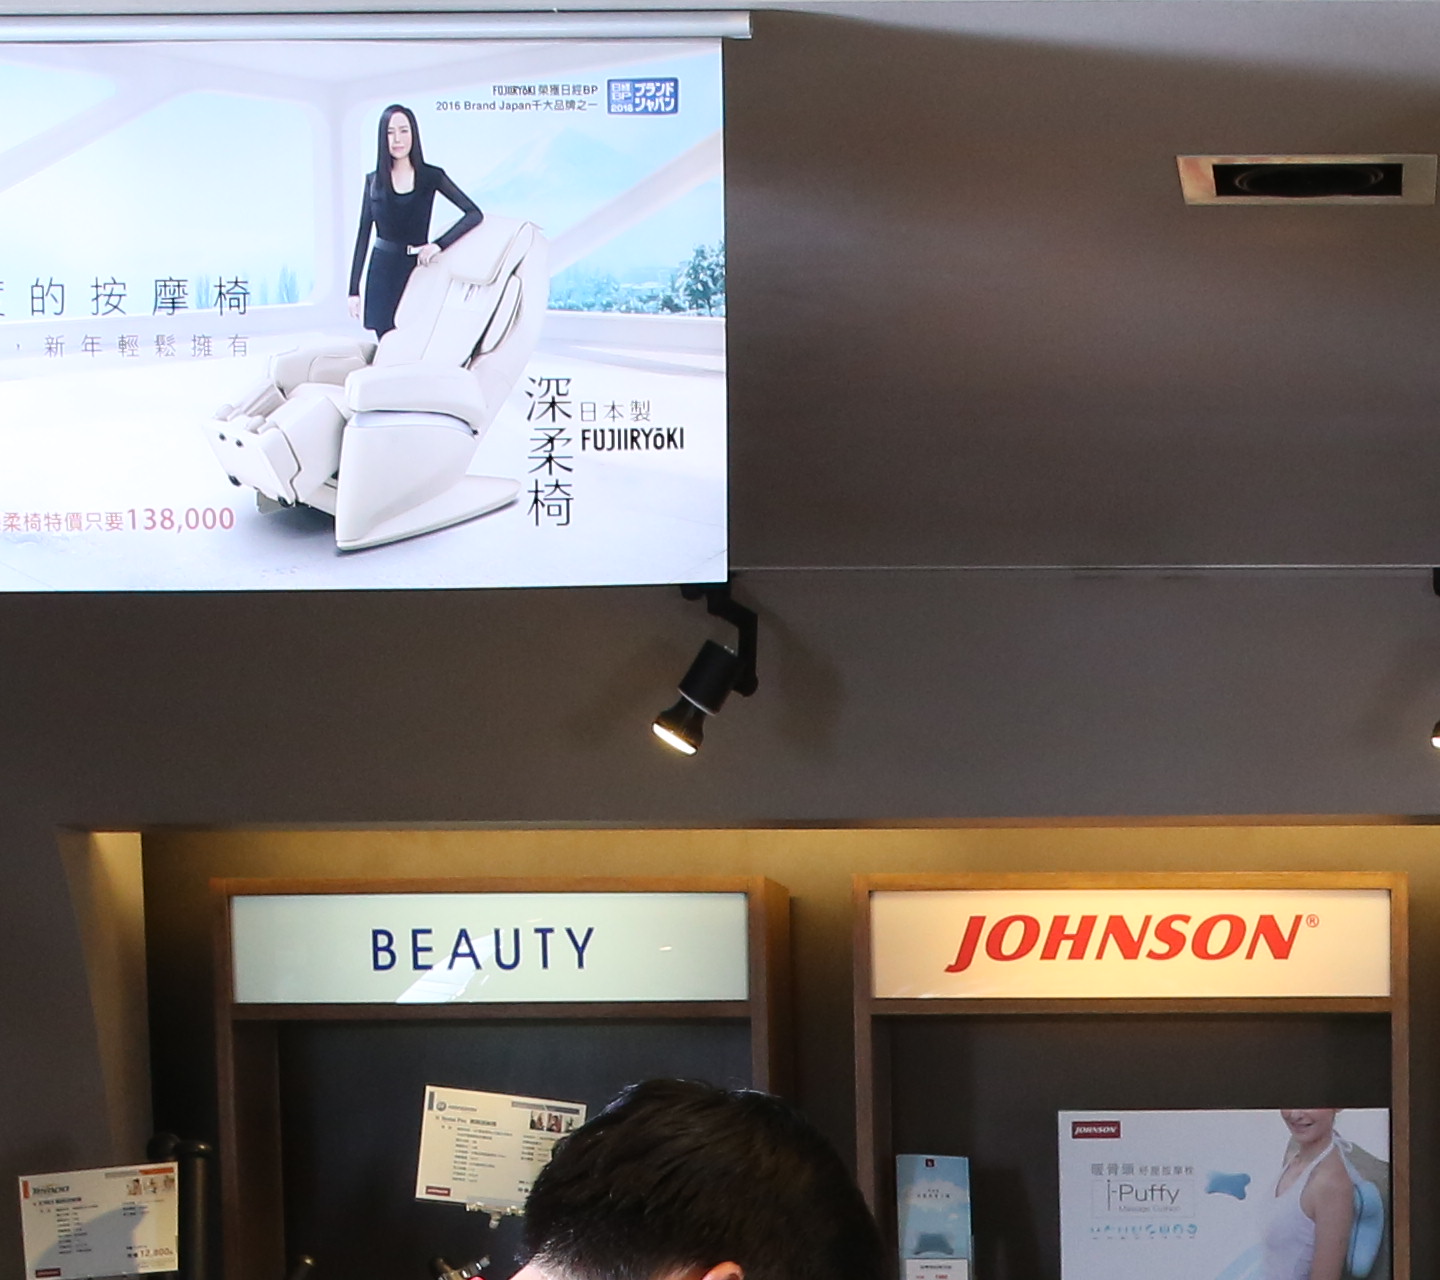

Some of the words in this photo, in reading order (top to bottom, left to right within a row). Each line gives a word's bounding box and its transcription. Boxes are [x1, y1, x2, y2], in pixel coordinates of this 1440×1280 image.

[635, 82, 675, 96] ブランド
[436, 101, 461, 111] 2016
[464, 100, 496, 111] Brand
[634, 96, 675, 112] ジャパン
[580, 399, 651, 422] 日本製
[524, 376, 574, 526] 深柔椅
[371, 927, 596, 971] BEAUTY
[944, 914, 1303, 973] JOHNSON
[1074, 1126, 1119, 1136] JOHNSON
